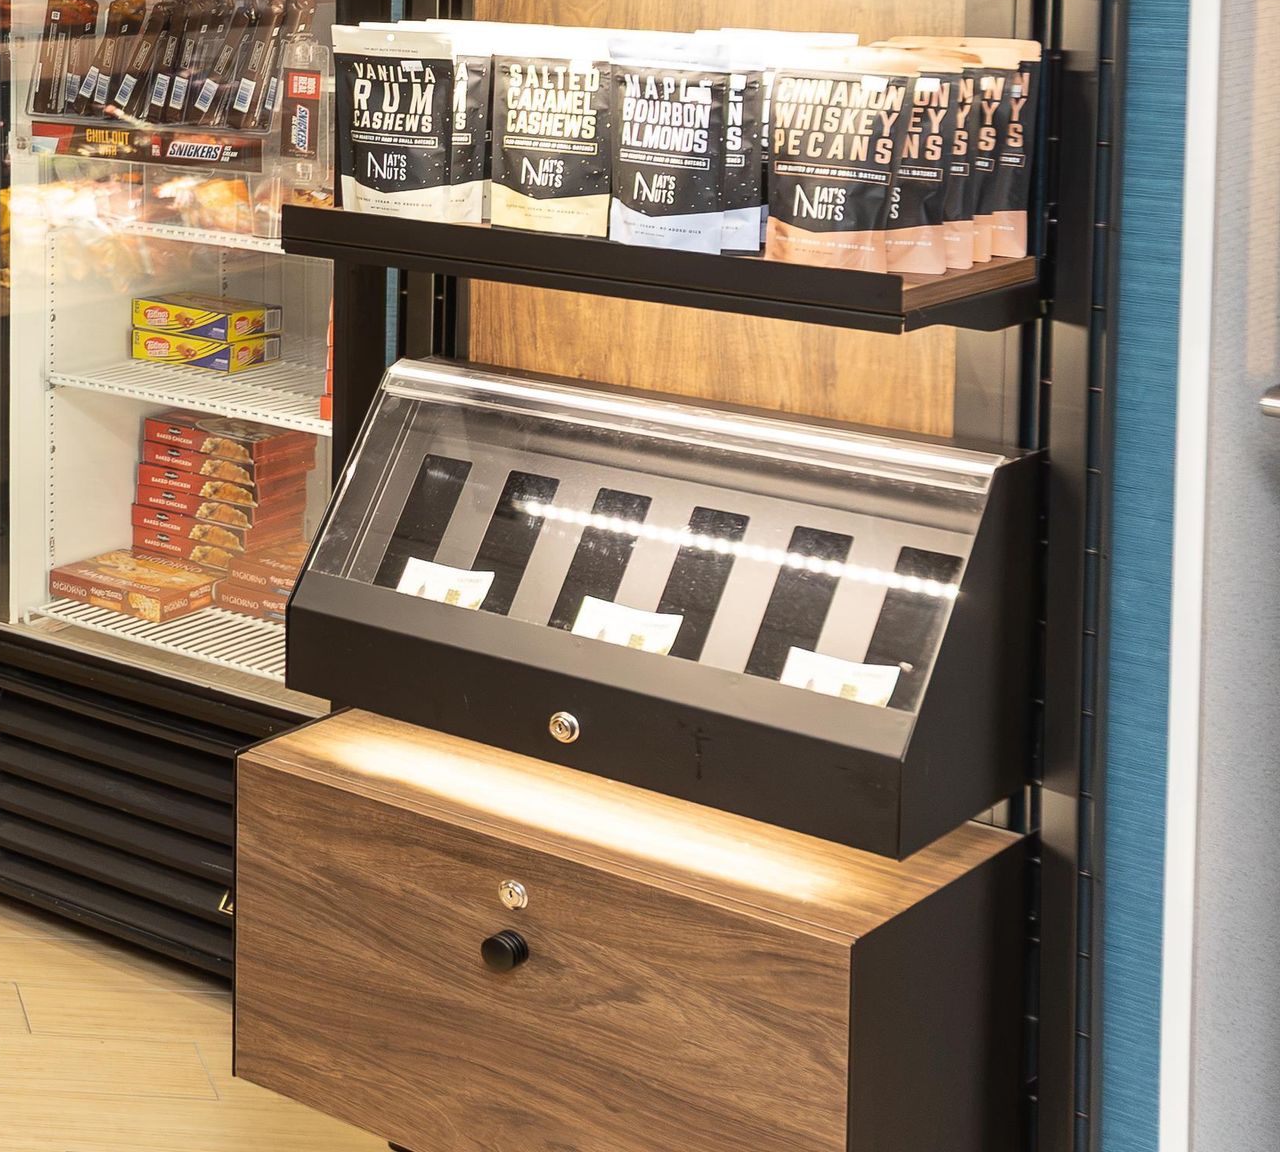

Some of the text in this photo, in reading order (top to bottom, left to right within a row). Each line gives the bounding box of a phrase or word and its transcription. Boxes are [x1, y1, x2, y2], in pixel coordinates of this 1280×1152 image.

[353, 61, 436, 84] VANILLA
[509, 64, 600, 93] SALTED
[353, 79, 434, 115] RUM
[507, 87, 598, 115] CARAMEL
[777, 77, 906, 112] CINNAMON
[296, 104, 310, 151] SNICKERS
[353, 110, 433, 133] CASHEWS
[506, 111, 597, 139] CASHEWS
[622, 98, 712, 129] BOURBON
[775, 104, 900, 137] WHISKEY
[85, 129, 130, 146] CHILL OUT
[166, 142, 222, 161] SNICKERS
[621, 122, 709, 154] ALMONDS
[774, 129, 894, 164] PECANS
[156, 432, 193, 445] BAKED CHICKEN
